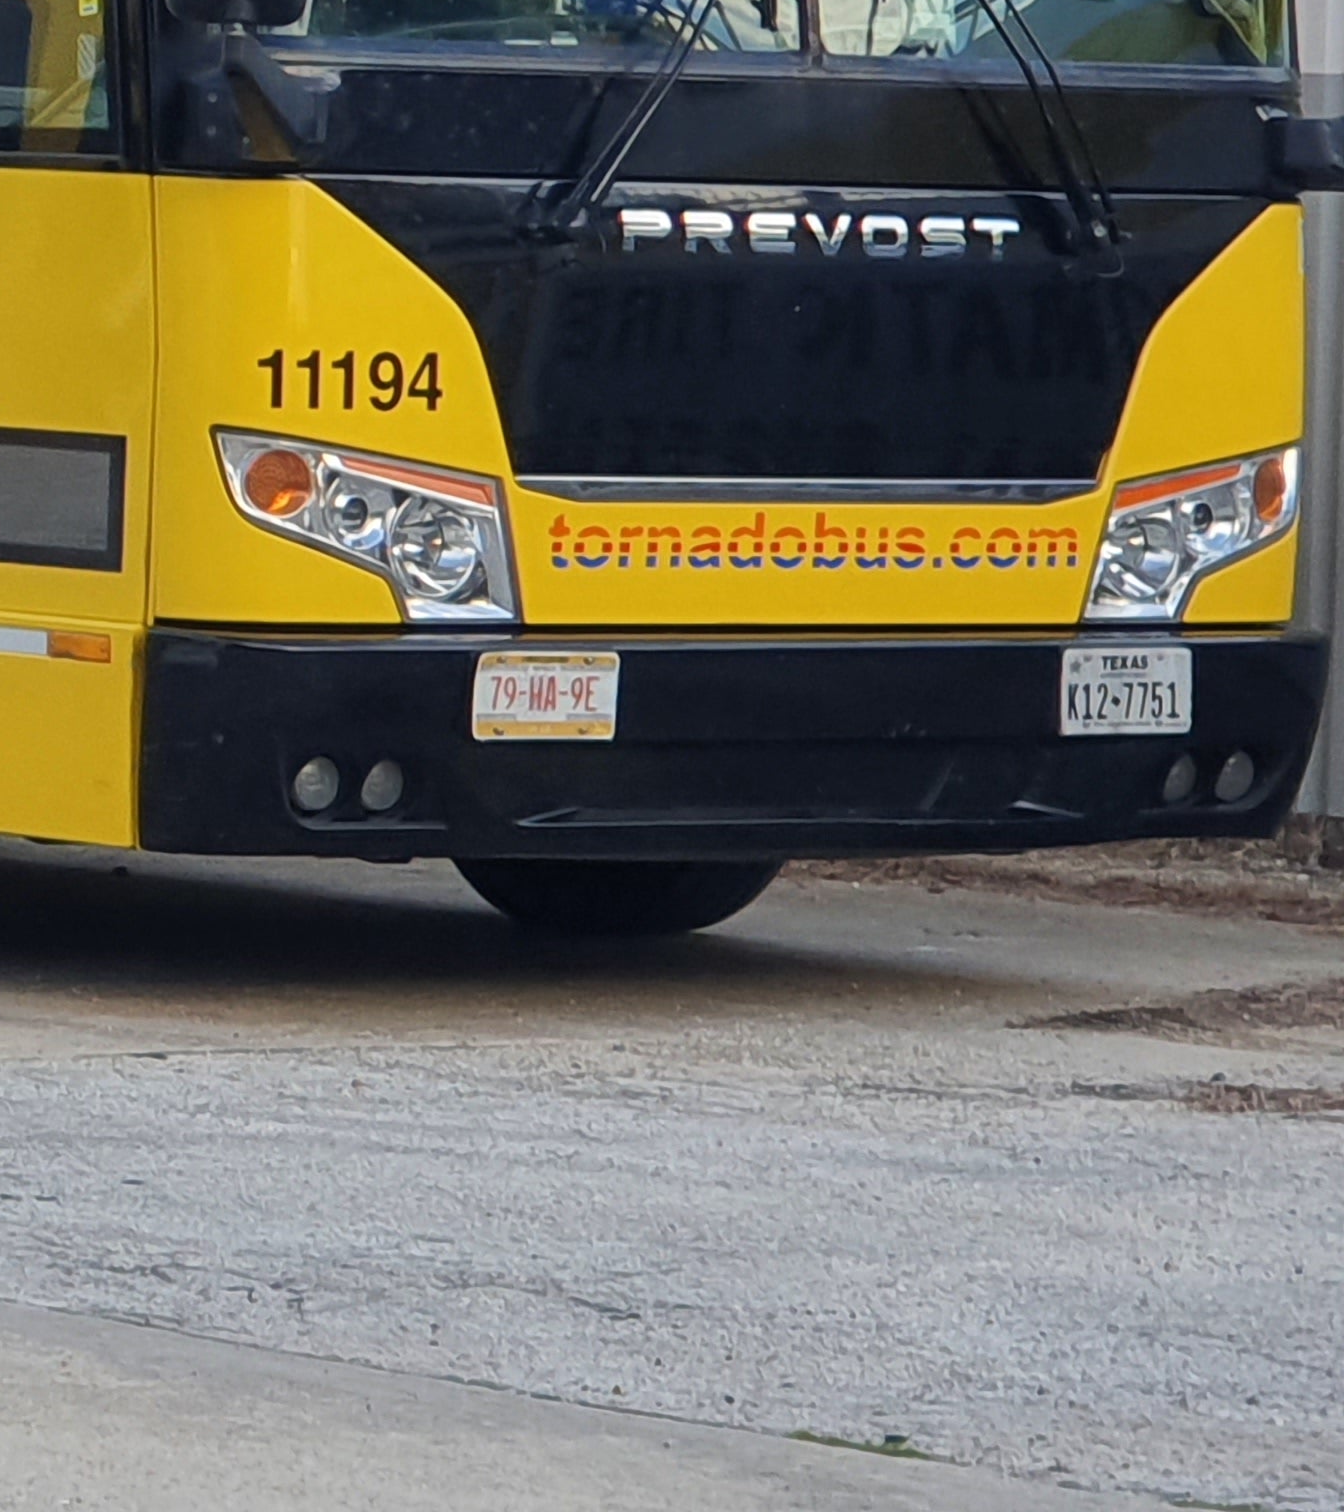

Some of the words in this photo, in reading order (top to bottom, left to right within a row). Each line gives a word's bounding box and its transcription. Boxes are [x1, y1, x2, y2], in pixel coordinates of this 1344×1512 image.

[617, 208, 1021, 261] PREVOST
[257, 349, 443, 412] 11194
[548, 512, 1079, 569] tornadobus.com
[1101, 655, 1149, 670] TEXAS
